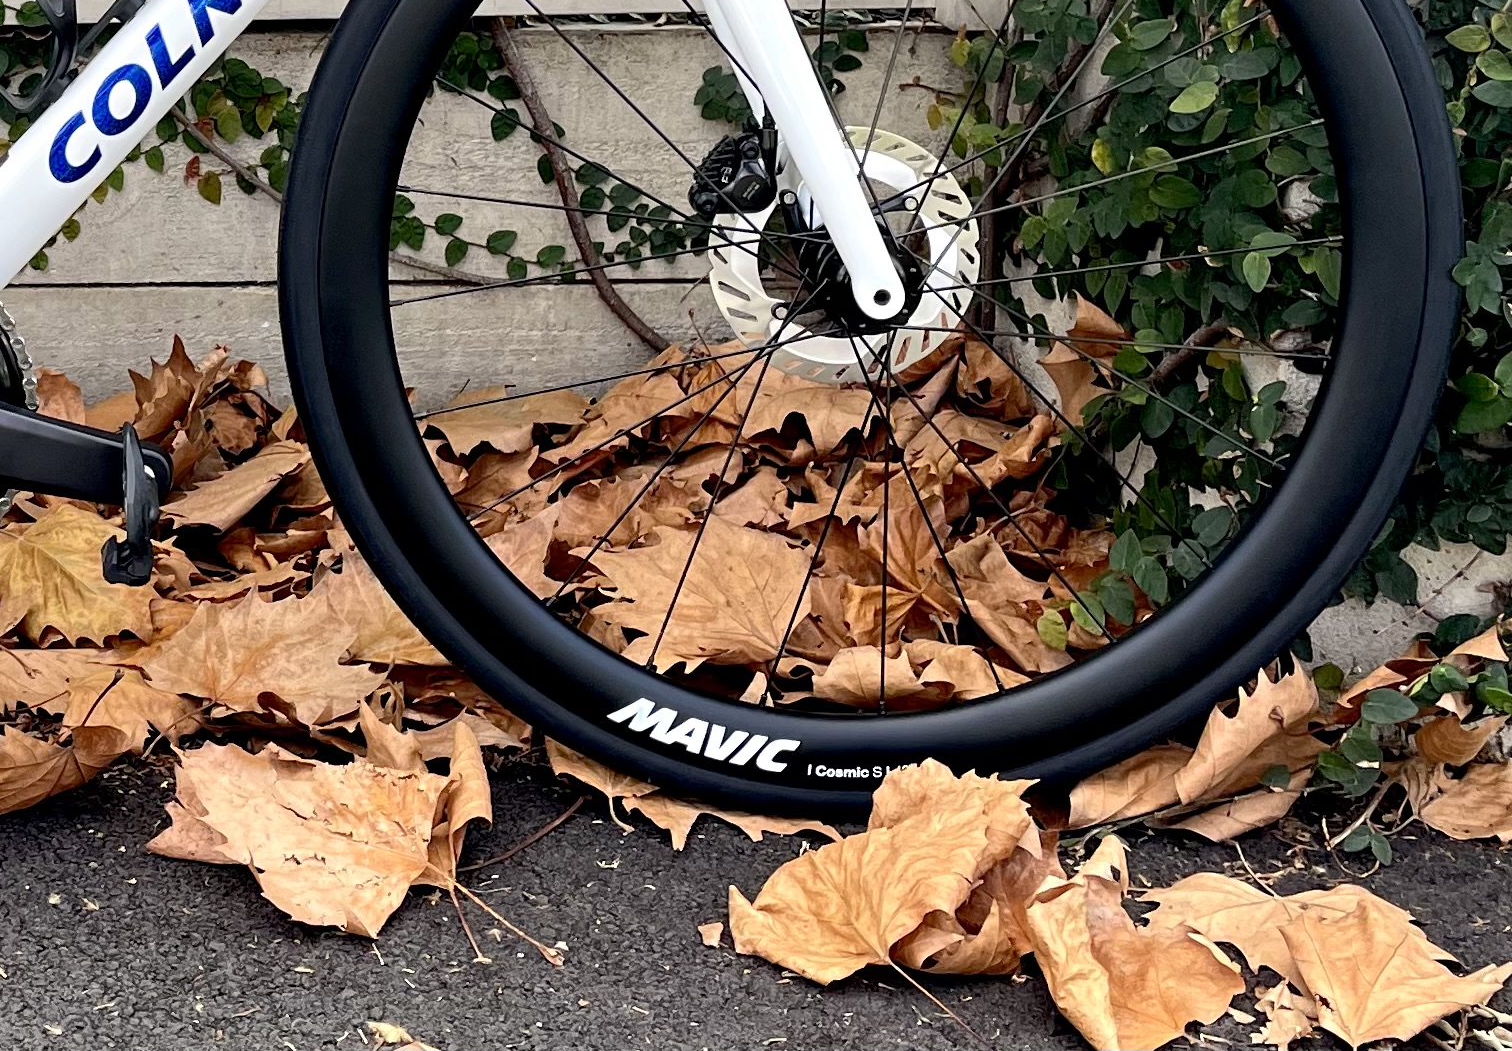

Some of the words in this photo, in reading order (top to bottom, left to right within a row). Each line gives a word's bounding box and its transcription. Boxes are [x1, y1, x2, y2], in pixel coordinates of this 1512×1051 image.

[606, 697, 801, 773] MAVIC
[815, 764, 870, 779] Cosmic
[872, 765, 883, 779] S
